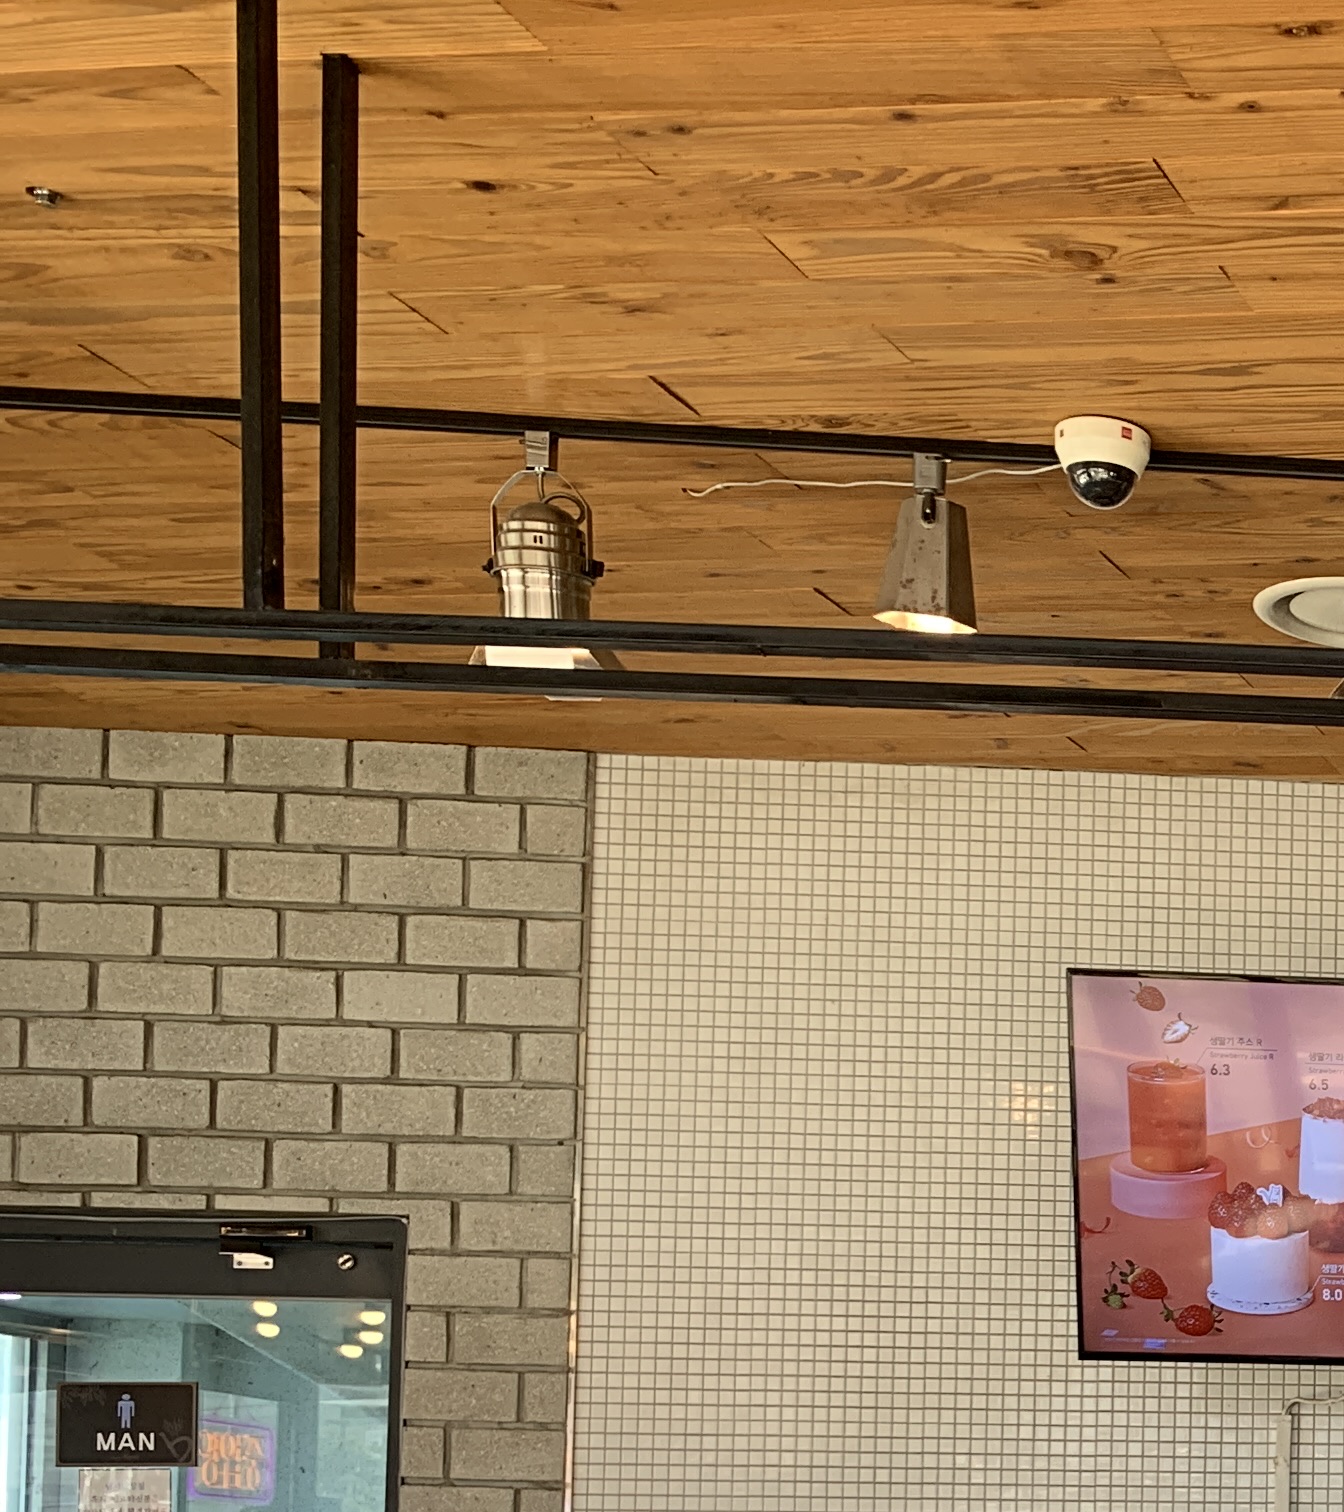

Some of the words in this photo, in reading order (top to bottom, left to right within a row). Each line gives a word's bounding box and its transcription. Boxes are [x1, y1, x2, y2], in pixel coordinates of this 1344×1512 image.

[1210, 1064, 1230, 1075] 6.3
[1309, 1079, 1329, 1091] 6.5
[1323, 1289, 1343, 1300] 8.0
[96, 1433, 155, 1452] MAN
